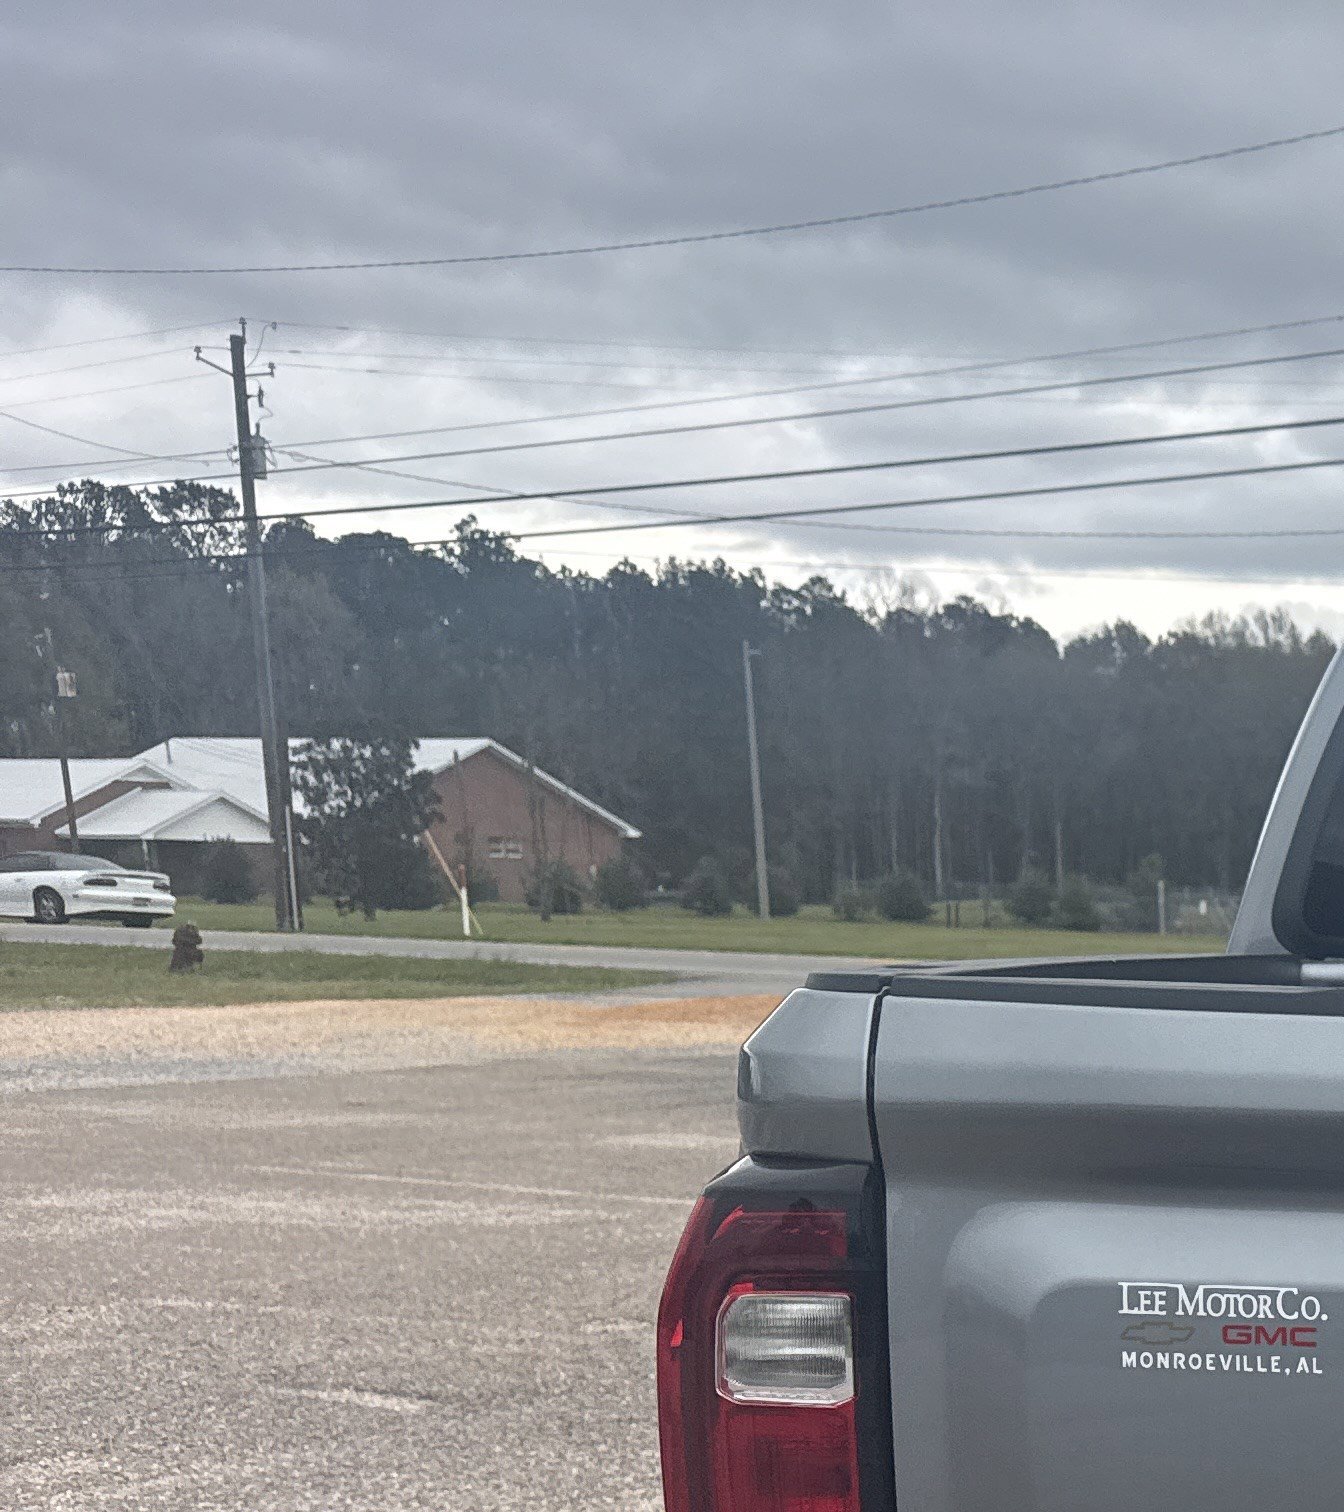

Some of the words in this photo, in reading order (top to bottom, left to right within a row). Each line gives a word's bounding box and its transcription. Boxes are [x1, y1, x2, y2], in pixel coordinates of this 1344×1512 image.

[1222, 1323, 1317, 1347] GMC
[1122, 1351, 1290, 1375] MONROEVILLE,
[1296, 1357, 1323, 1374] AL
